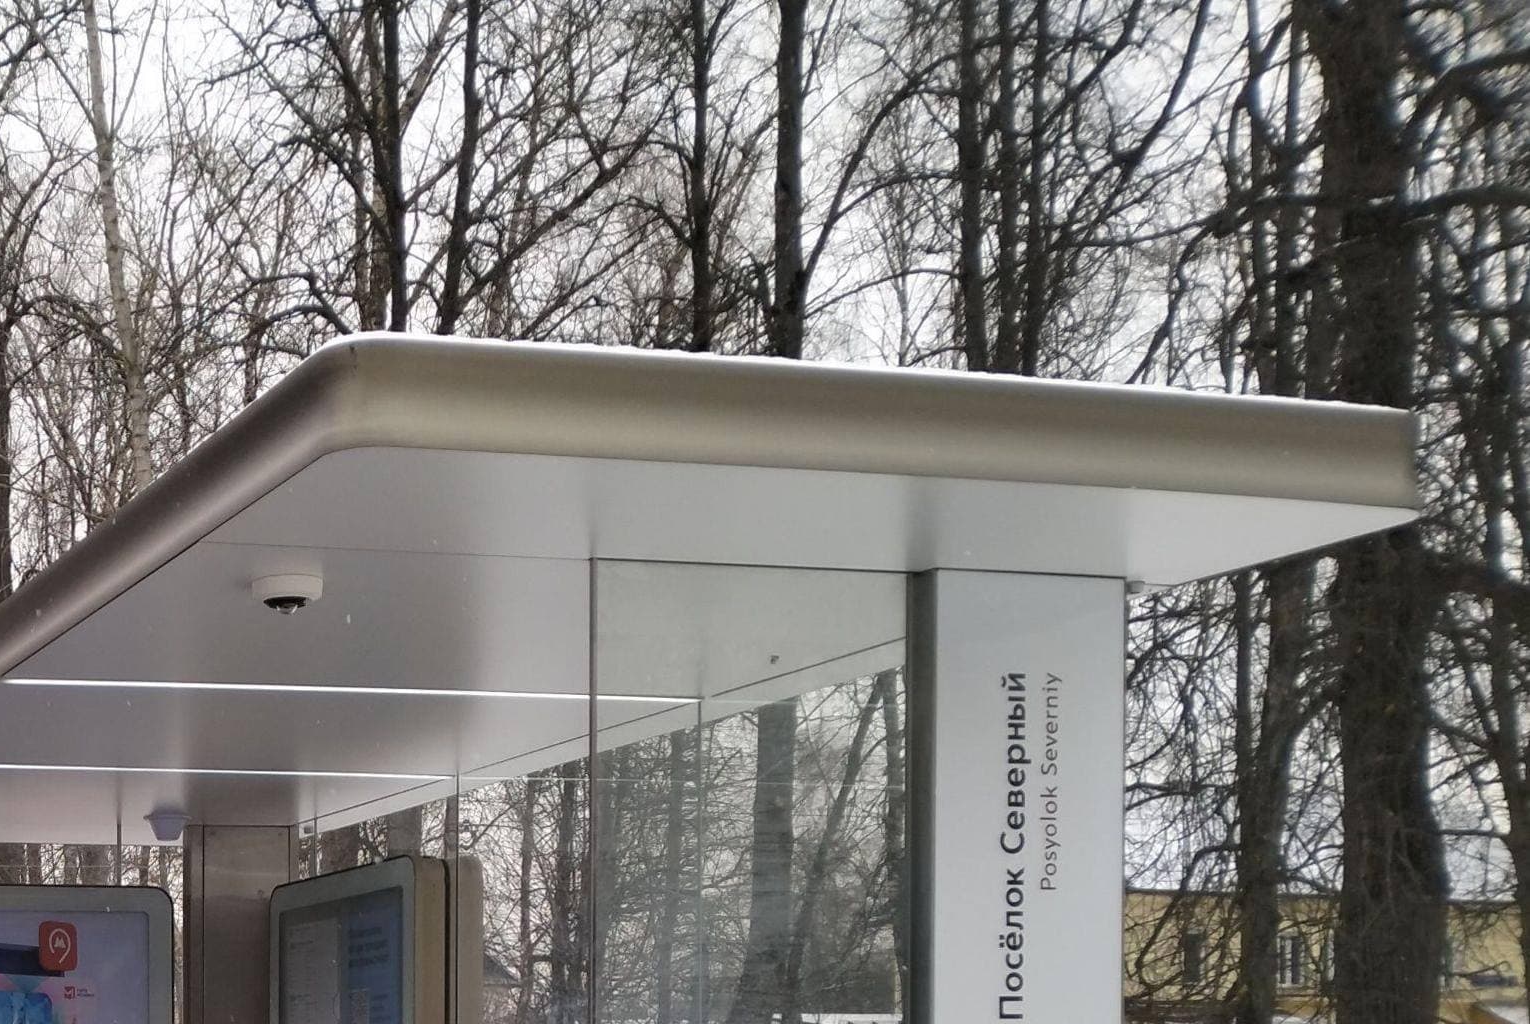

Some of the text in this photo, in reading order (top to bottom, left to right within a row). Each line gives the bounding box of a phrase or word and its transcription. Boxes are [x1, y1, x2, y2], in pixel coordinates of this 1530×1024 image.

[998, 672, 1032, 1020] Посёлок Северный
[1039, 672, 1063, 891] Posyolok Severniy
